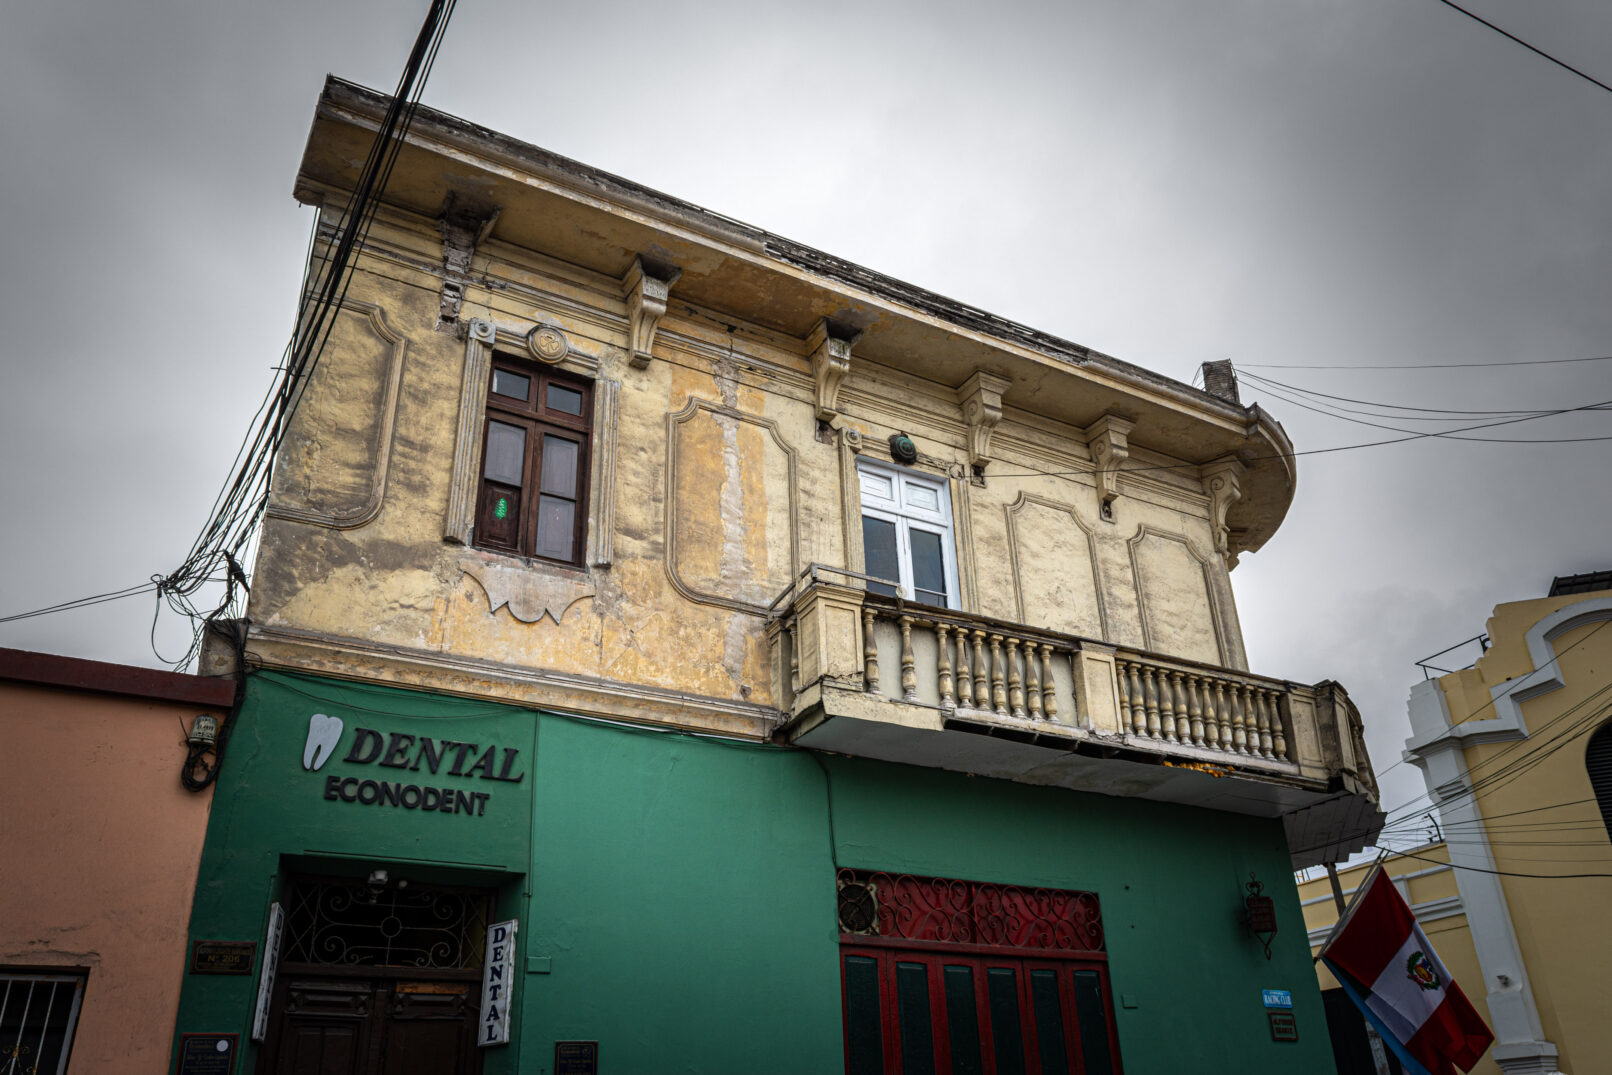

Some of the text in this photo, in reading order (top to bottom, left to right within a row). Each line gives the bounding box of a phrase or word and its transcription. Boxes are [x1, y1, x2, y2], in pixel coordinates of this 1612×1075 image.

[324, 775, 490, 817] ECONODENT
[343, 727, 525, 783] DENTAL
[260, 913, 283, 1037] DENTAL
[486, 926, 507, 1042] DENTAL
